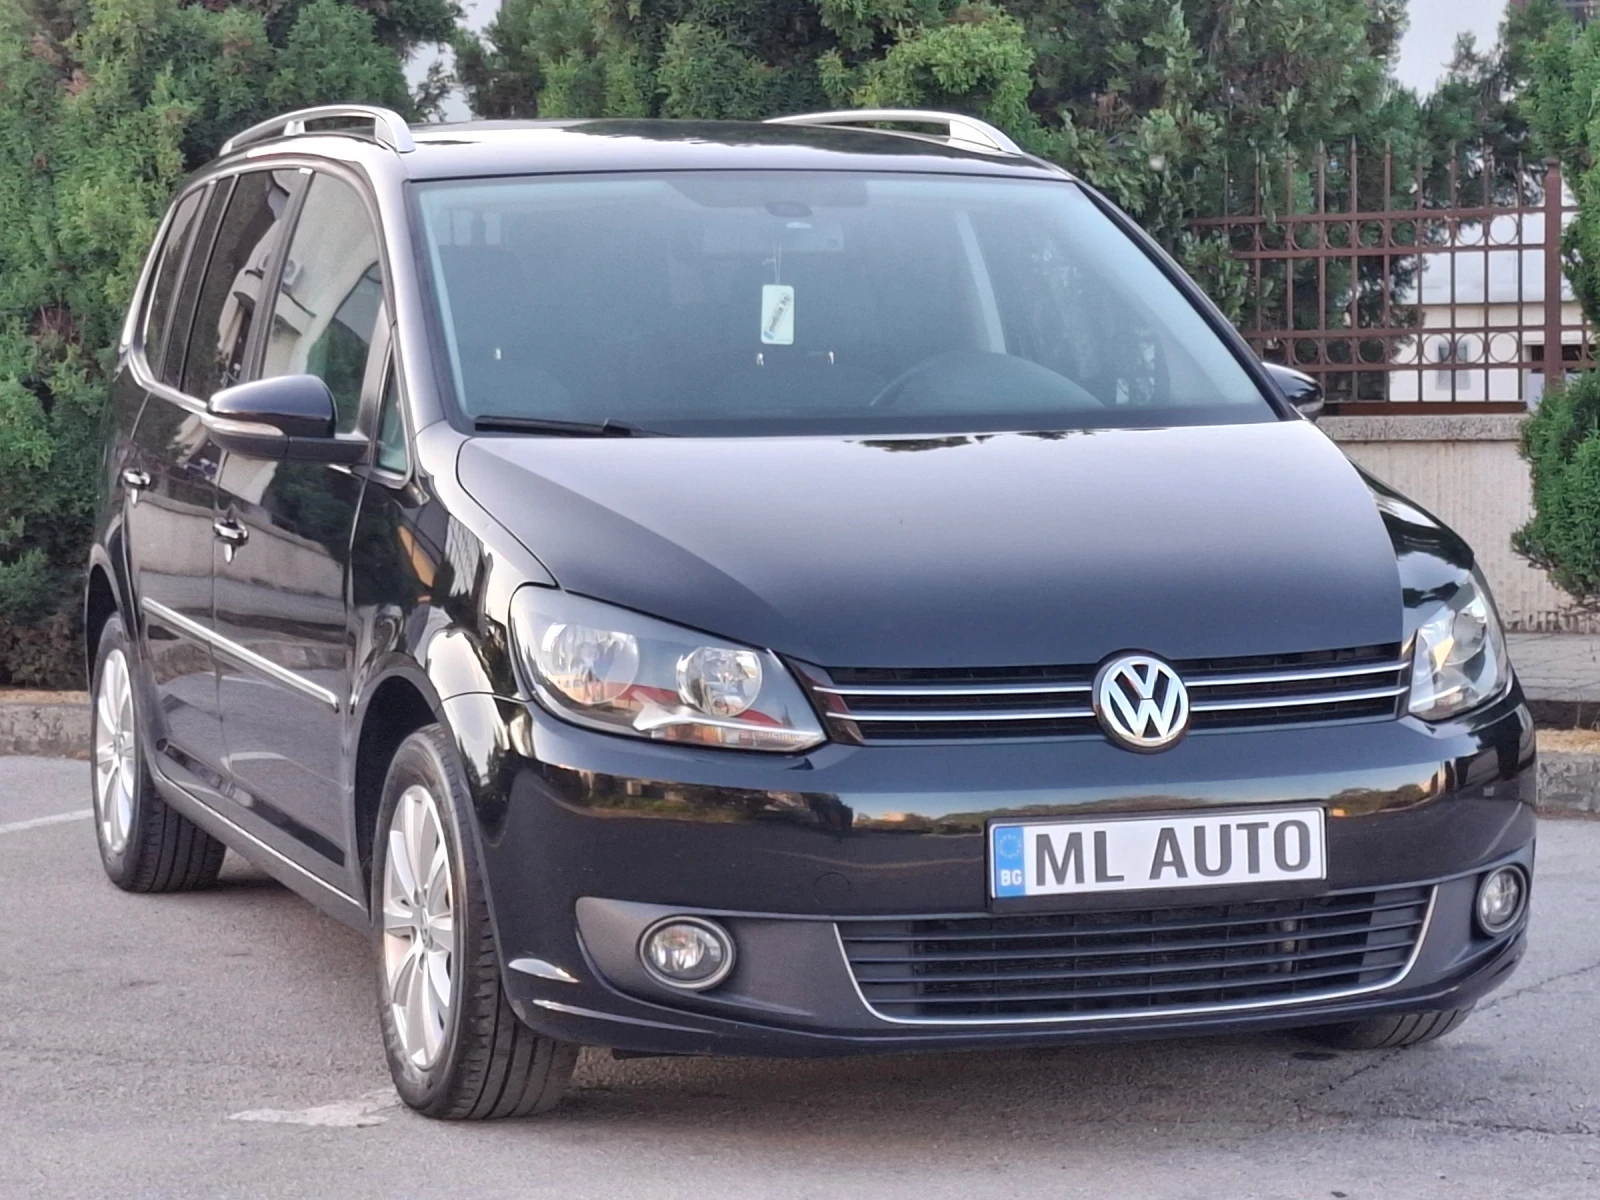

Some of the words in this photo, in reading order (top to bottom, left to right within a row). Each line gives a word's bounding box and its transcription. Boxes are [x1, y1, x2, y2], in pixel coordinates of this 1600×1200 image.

[1101, 657, 1188, 746] VW
[1000, 869, 1023, 886] BG
[1035, 831, 1125, 886] ML
[1148, 819, 1311, 880] AUTO
